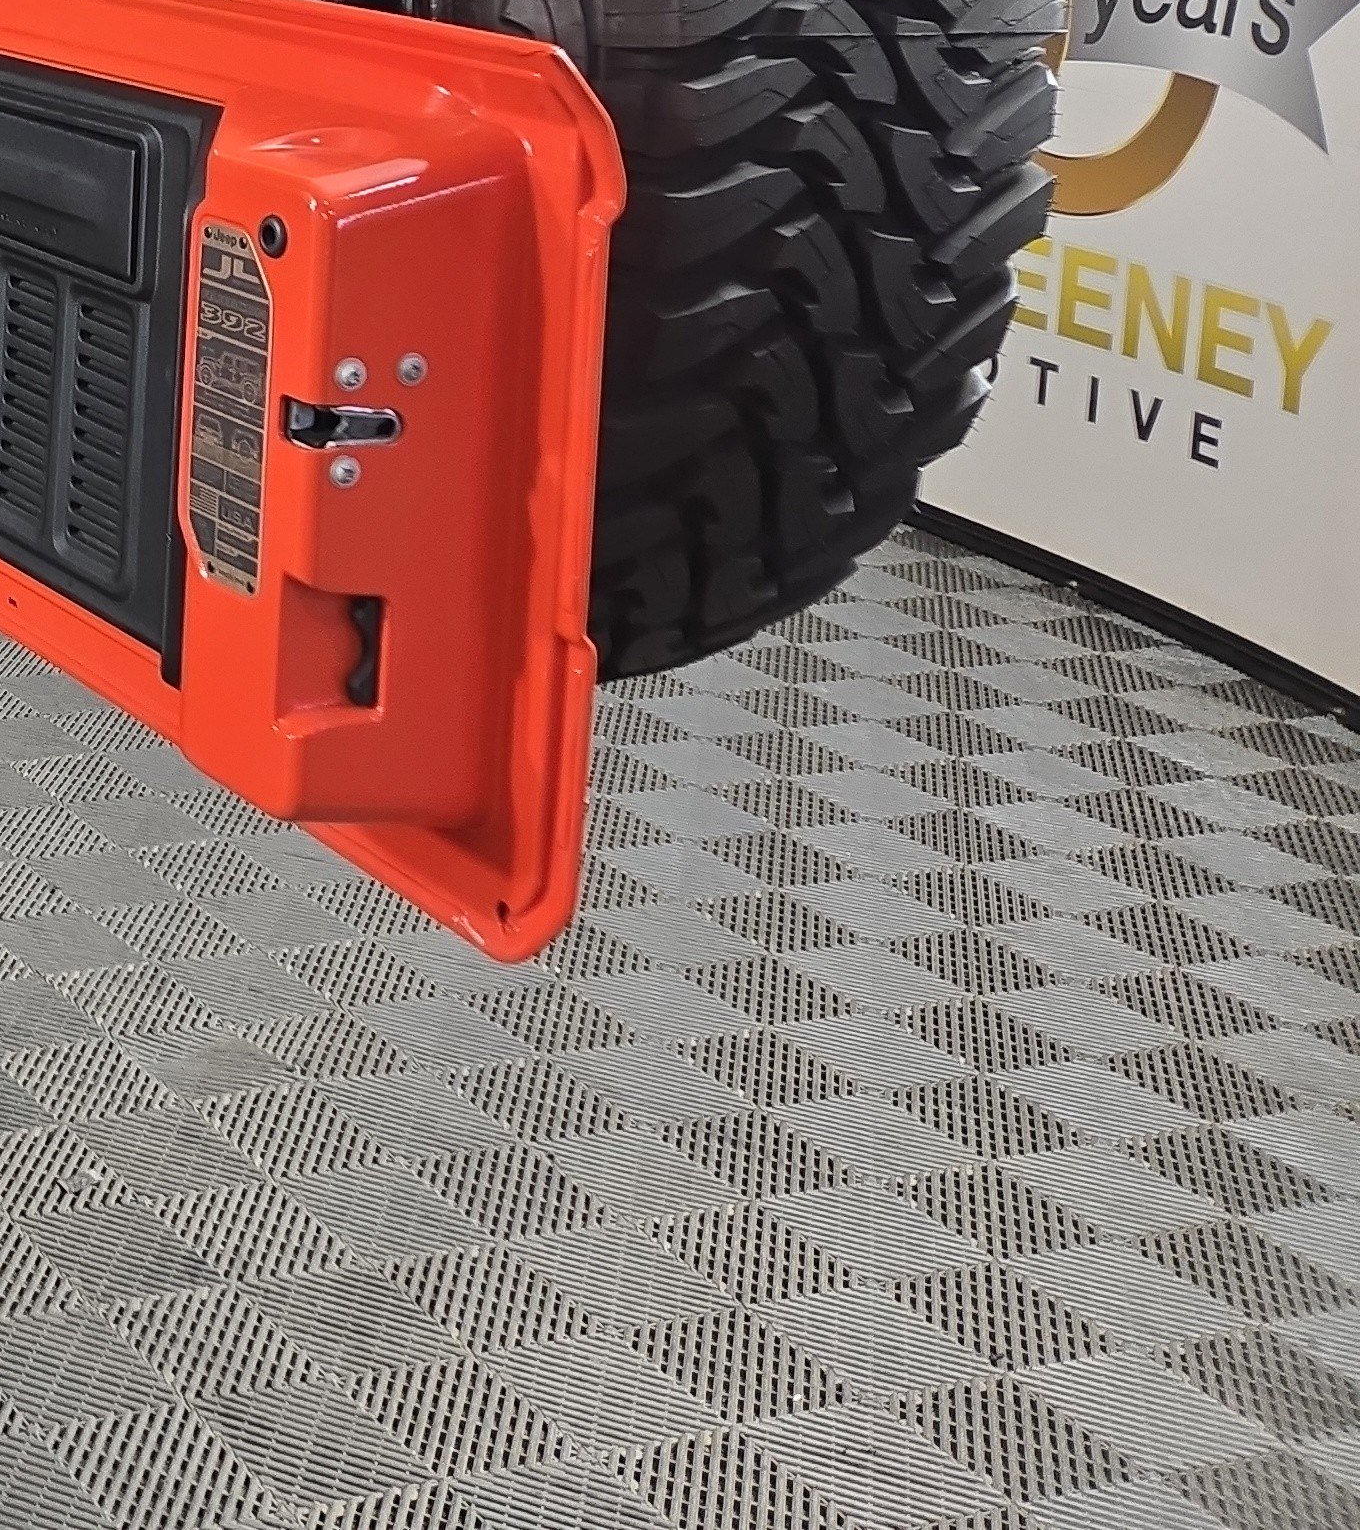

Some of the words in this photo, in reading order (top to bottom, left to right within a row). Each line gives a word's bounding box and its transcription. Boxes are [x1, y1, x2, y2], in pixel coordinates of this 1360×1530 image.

[213, 228, 237, 249] Jeep
[202, 254, 261, 285] JL
[200, 301, 267, 343] 392
[1011, 237, 1334, 416] EENEY
[221, 503, 256, 533] USA
